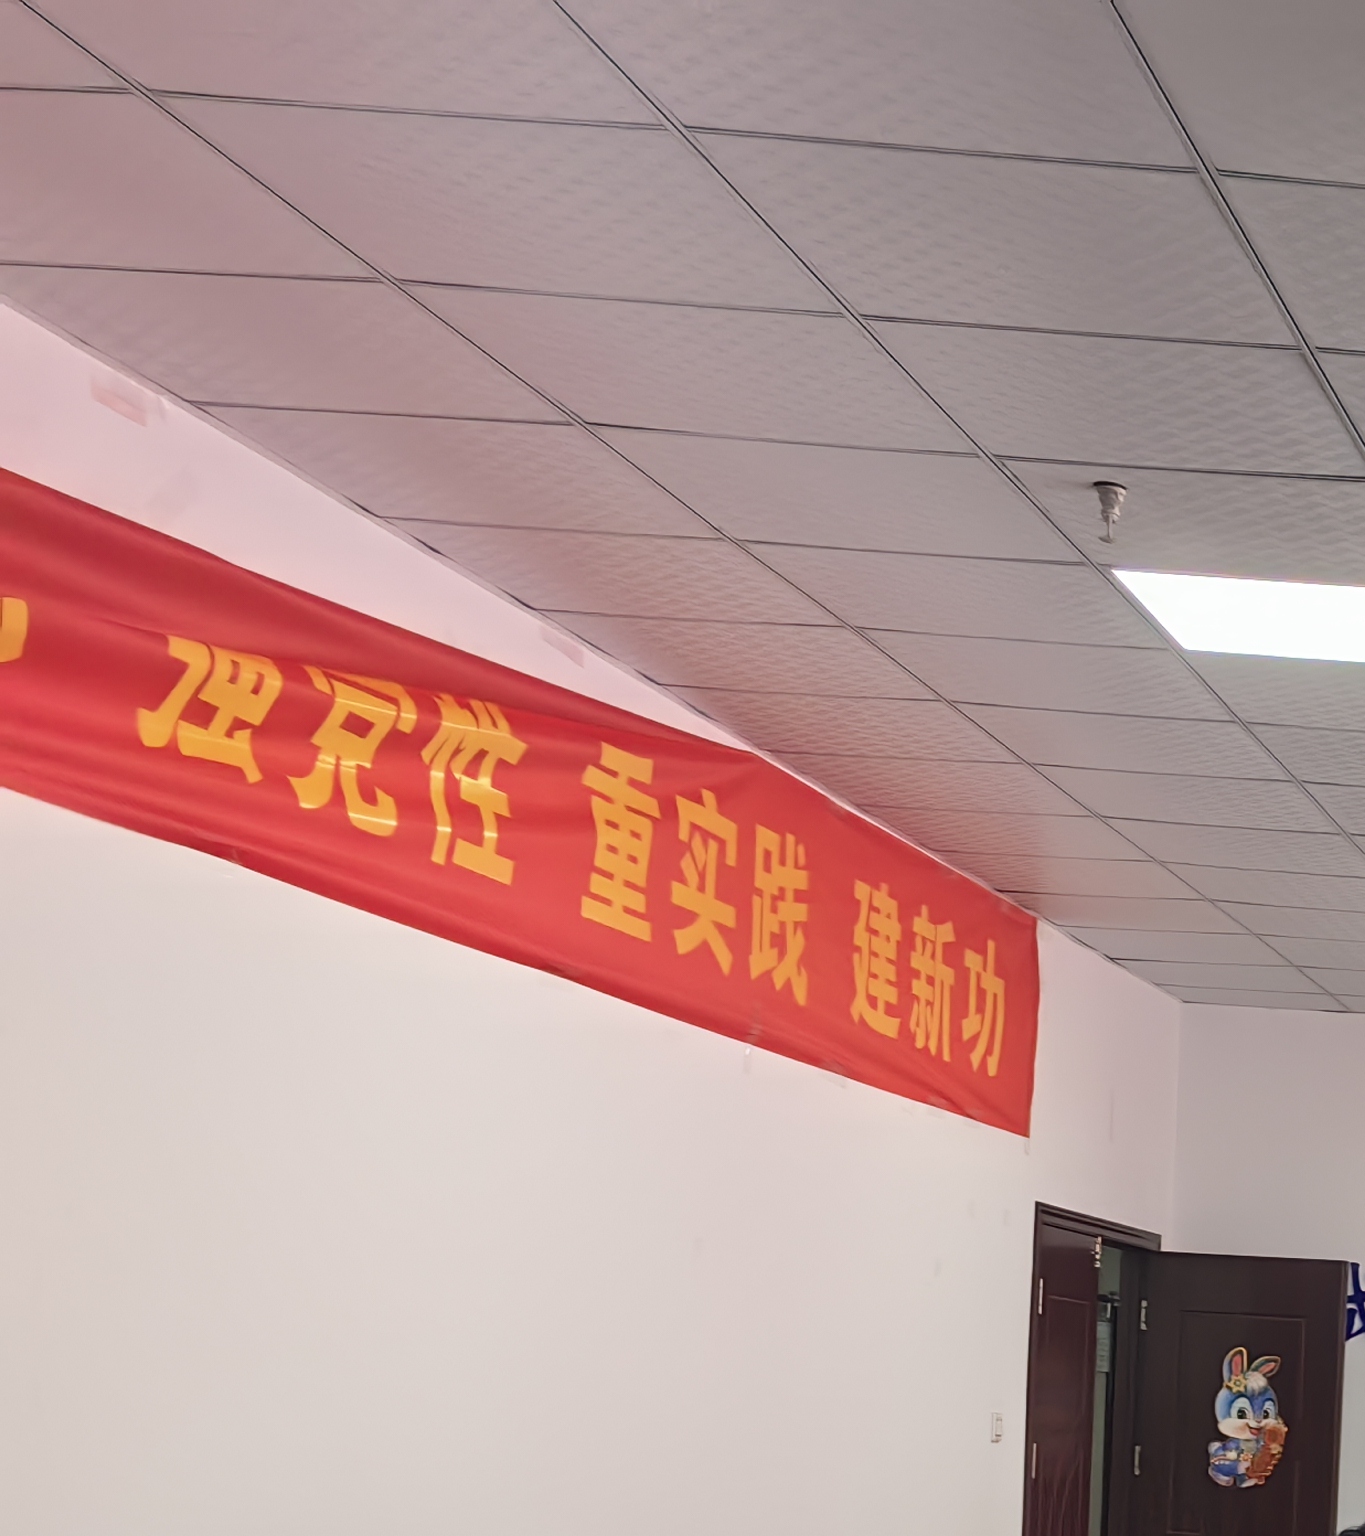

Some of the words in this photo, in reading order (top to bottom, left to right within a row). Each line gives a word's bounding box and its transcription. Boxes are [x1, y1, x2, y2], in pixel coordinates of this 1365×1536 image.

[580, 741, 809, 1007] 重实践
[849, 879, 1005, 1078] 建新功
